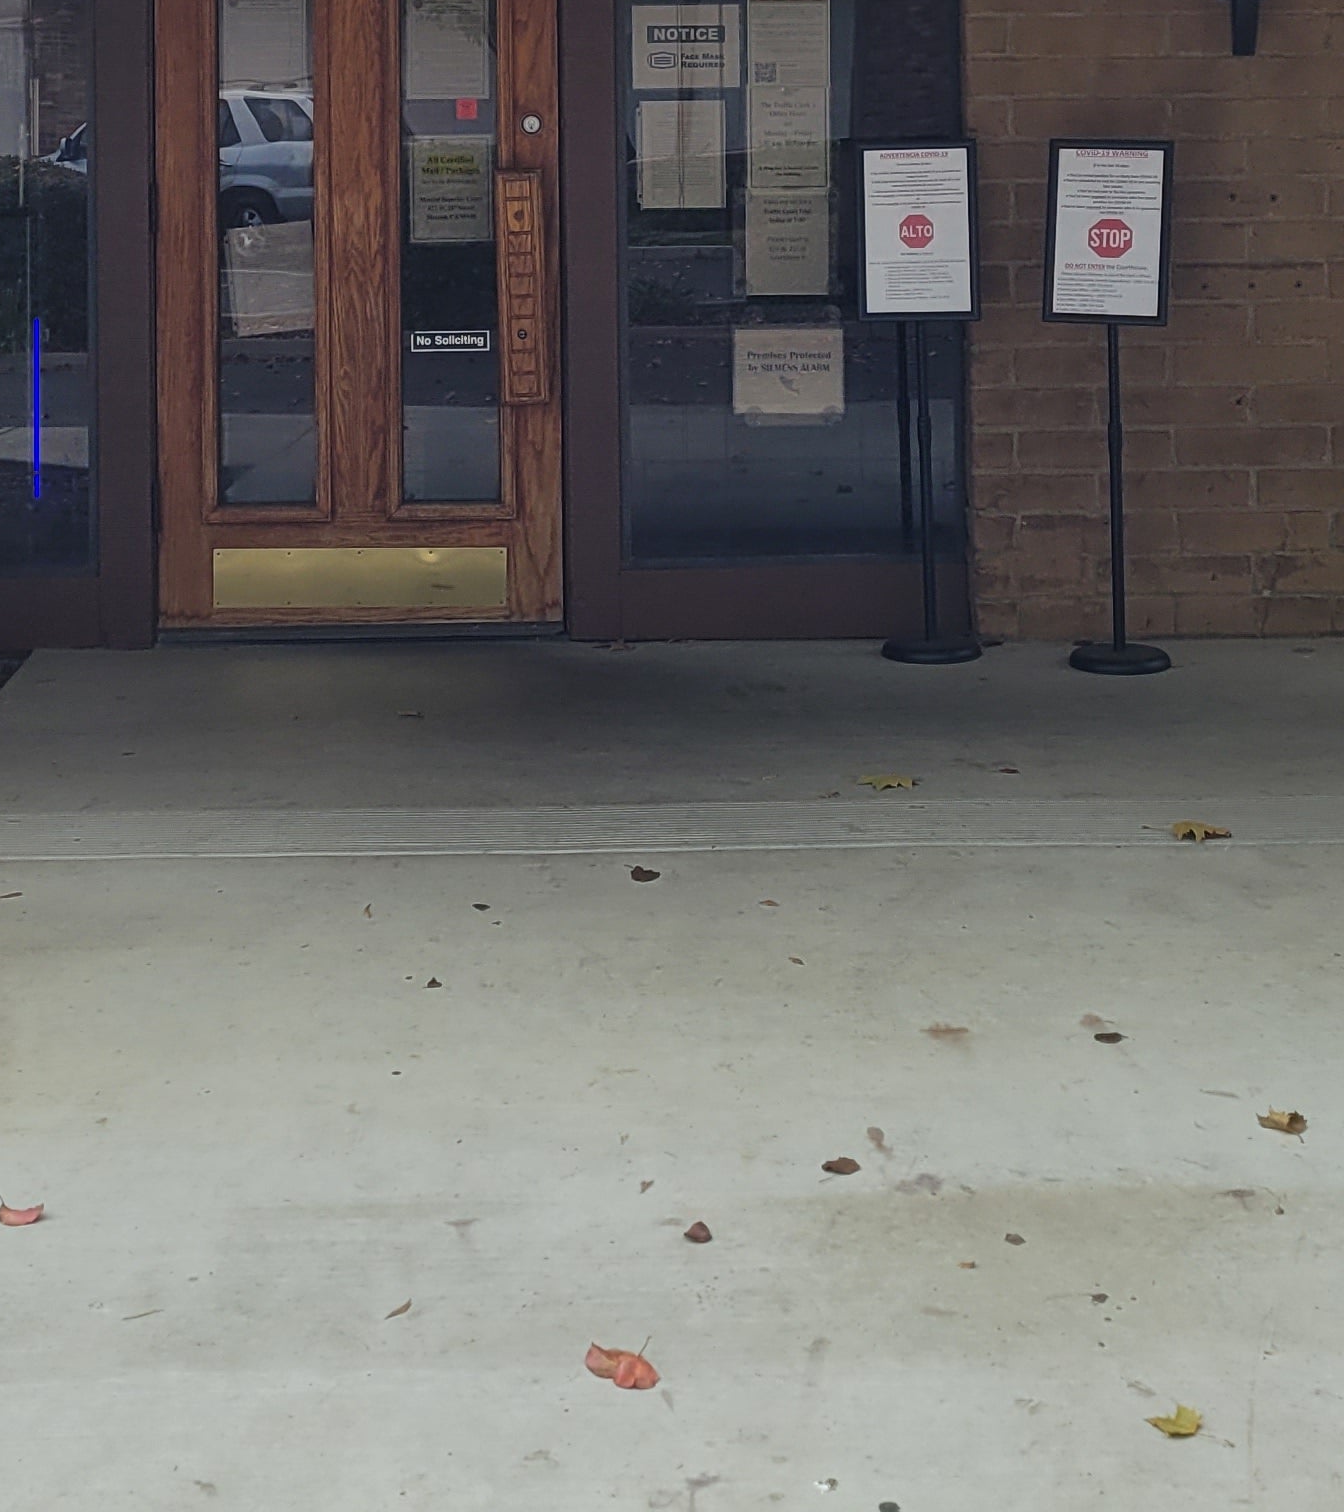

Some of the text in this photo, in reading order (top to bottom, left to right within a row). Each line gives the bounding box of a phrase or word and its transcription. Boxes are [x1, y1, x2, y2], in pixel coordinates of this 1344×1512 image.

[653, 28, 719, 41] NOTICE
[1112, 150, 1148, 158] WARNING
[901, 225, 932, 238] ALTO
[1090, 229, 1131, 248] STOP
[416, 334, 484, 347] No Soliciting
[747, 351, 831, 359] Premises Protected
